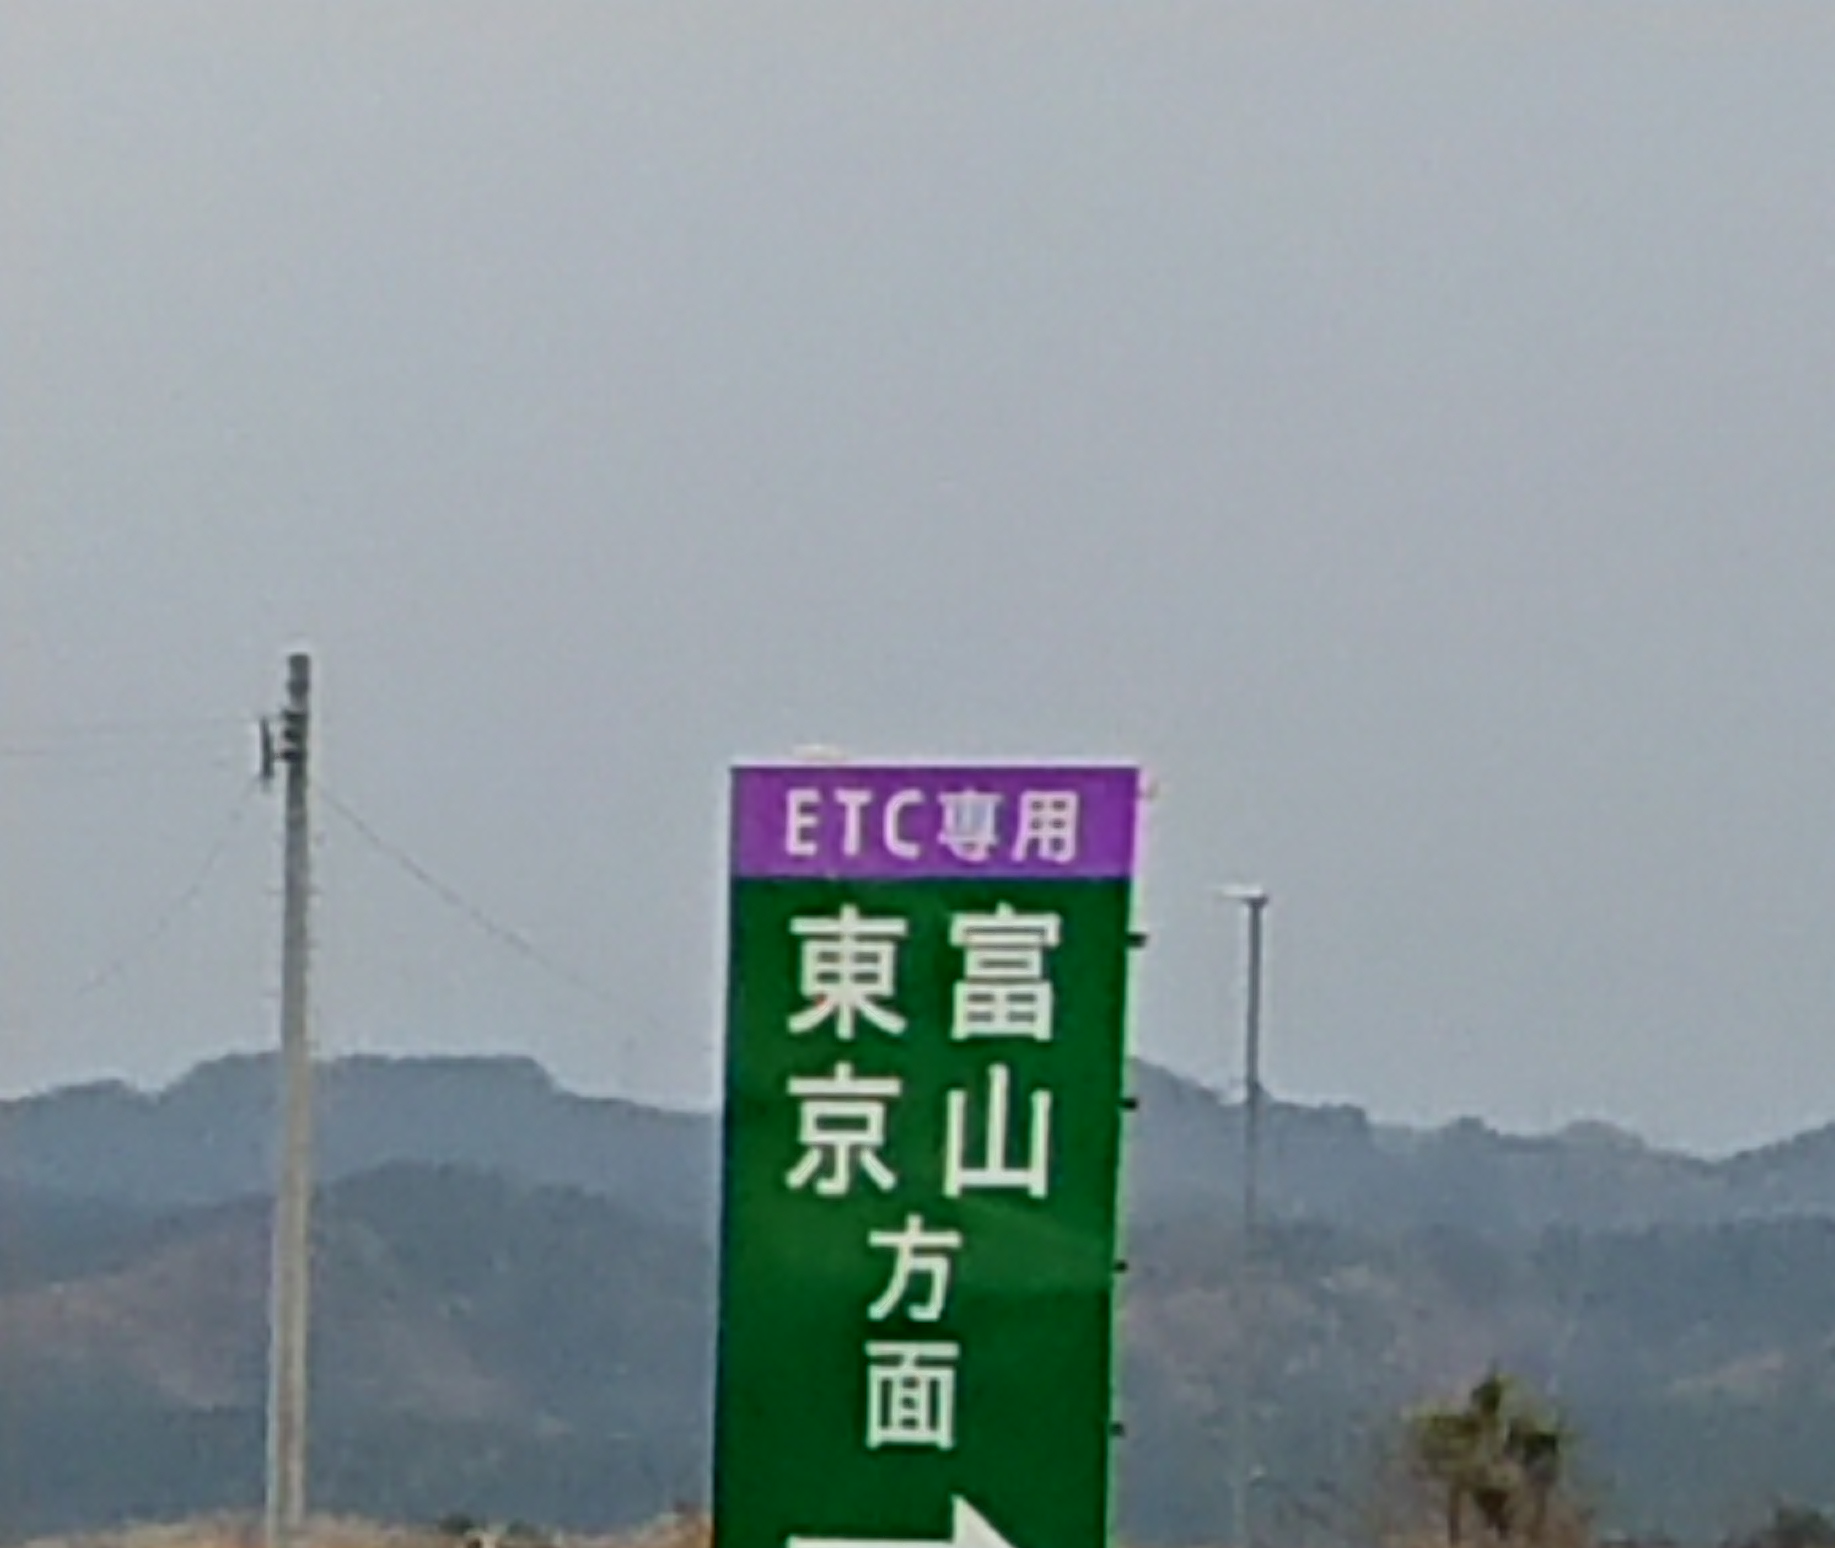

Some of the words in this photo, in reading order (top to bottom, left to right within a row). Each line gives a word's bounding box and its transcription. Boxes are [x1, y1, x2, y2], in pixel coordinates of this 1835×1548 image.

[783, 788, 1082, 864] ETC専用
[786, 903, 908, 1198] 東京
[943, 902, 1062, 1200] 富山
[865, 1212, 963, 1450] 方面
